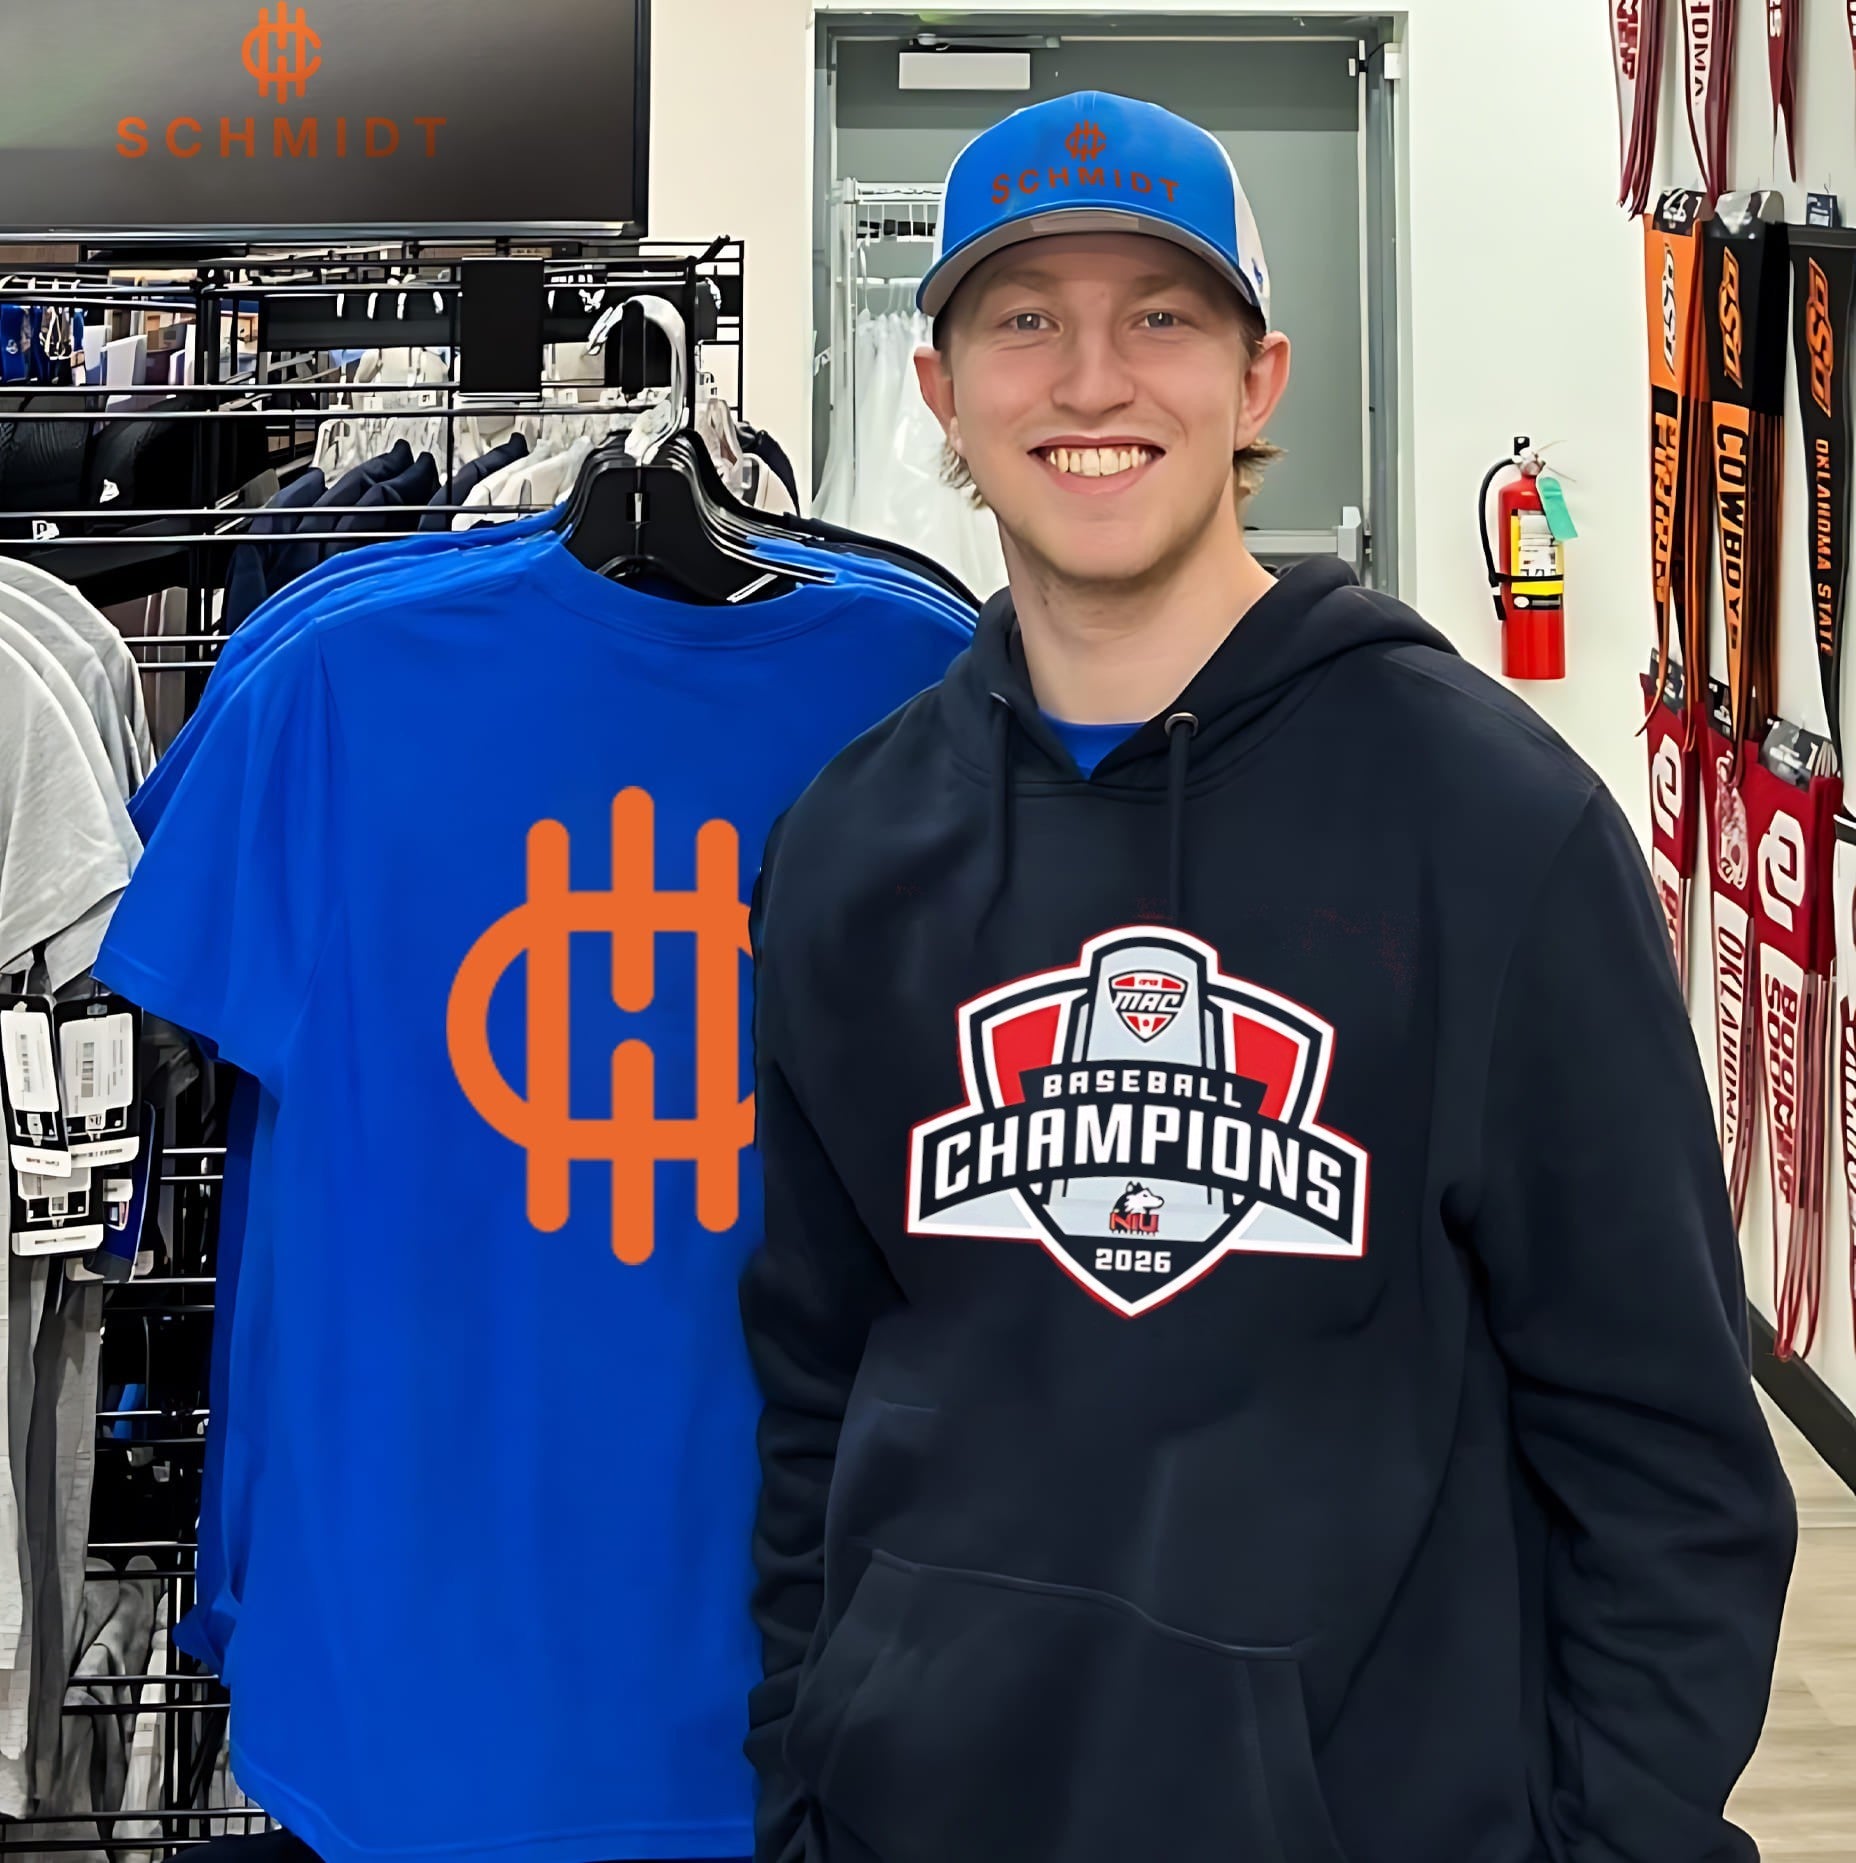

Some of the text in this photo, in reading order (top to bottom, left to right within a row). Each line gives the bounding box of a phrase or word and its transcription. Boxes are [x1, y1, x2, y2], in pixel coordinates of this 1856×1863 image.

[116, 117, 447, 158] SCHMIDT
[991, 167, 1179, 205] SCHMIDT
[1113, 991, 1183, 1012] MAC
[1043, 1069, 1242, 1108] BASEBALL
[934, 1103, 1342, 1221] CHAMPIONS
[1109, 1211, 1160, 1234] NIU
[1095, 1248, 1172, 1273] 2026
